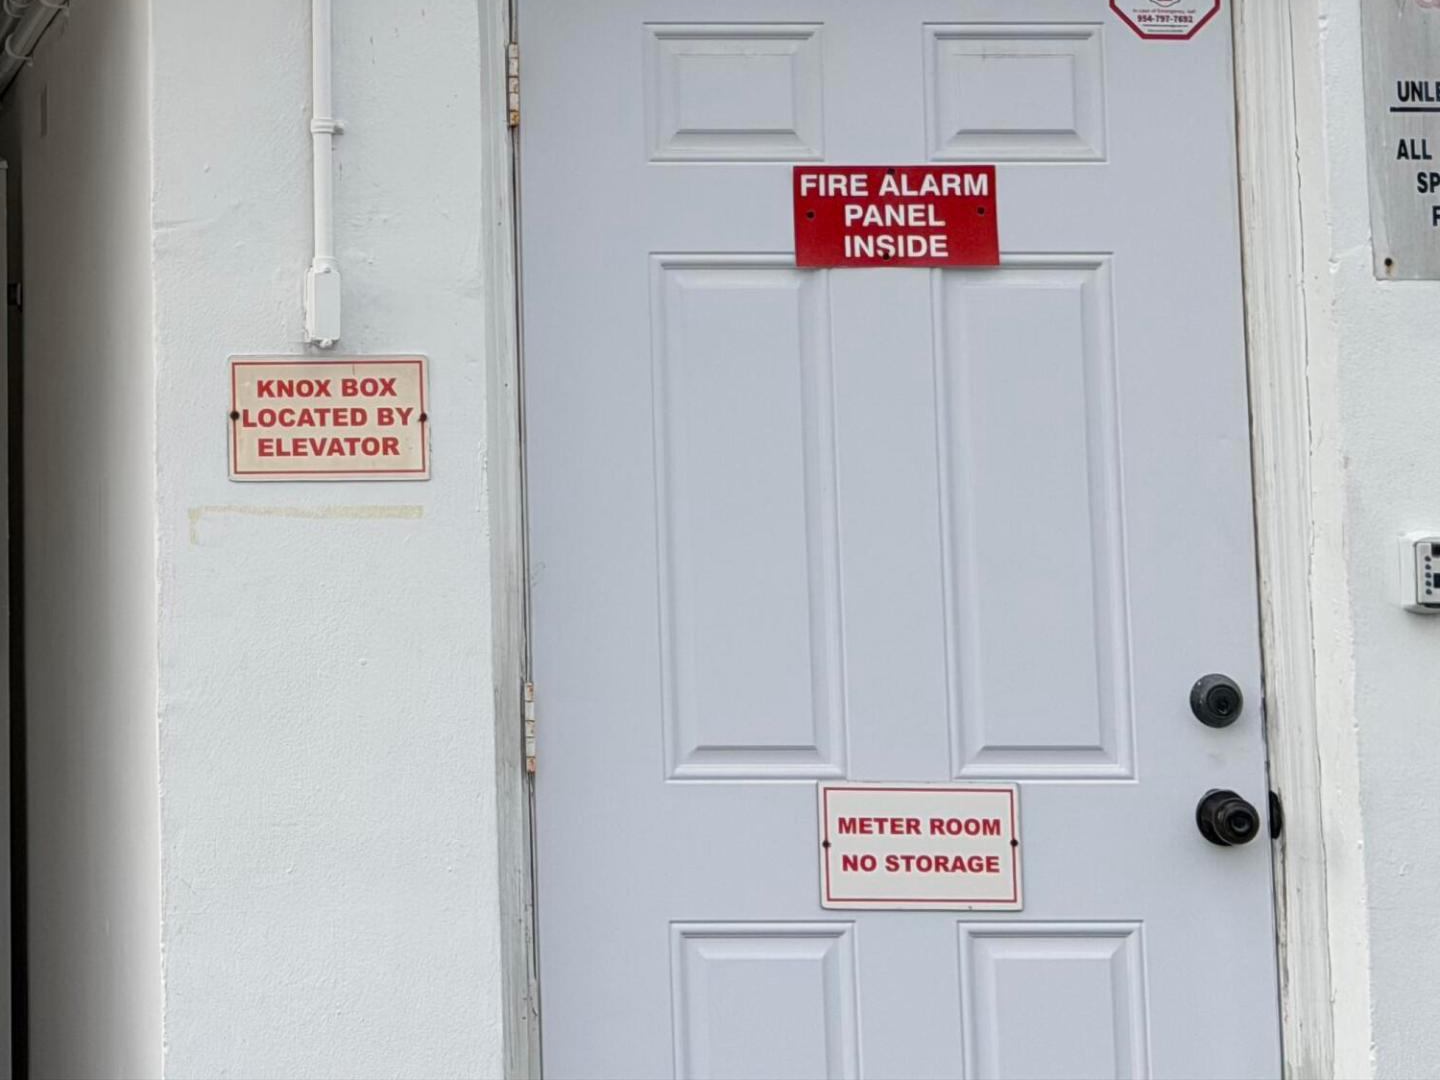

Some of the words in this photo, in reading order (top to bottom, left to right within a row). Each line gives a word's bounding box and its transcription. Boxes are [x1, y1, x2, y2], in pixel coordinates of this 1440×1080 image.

[1397, 138, 1432, 160] ALL
[800, 174, 868, 197] FIRE
[879, 173, 988, 196] ALARM
[845, 204, 946, 227] PANEL
[844, 235, 948, 258] INSIDE
[256, 379, 331, 398] KNOX
[341, 378, 397, 397] BOX
[242, 408, 367, 428] LOCATED
[377, 407, 414, 426] BY
[258, 437, 400, 457] ELEVATOR
[838, 817, 922, 835] METER
[930, 818, 1001, 836] ROOM
[842, 854, 877, 872] NO
[885, 855, 1000, 873] STORAGE
